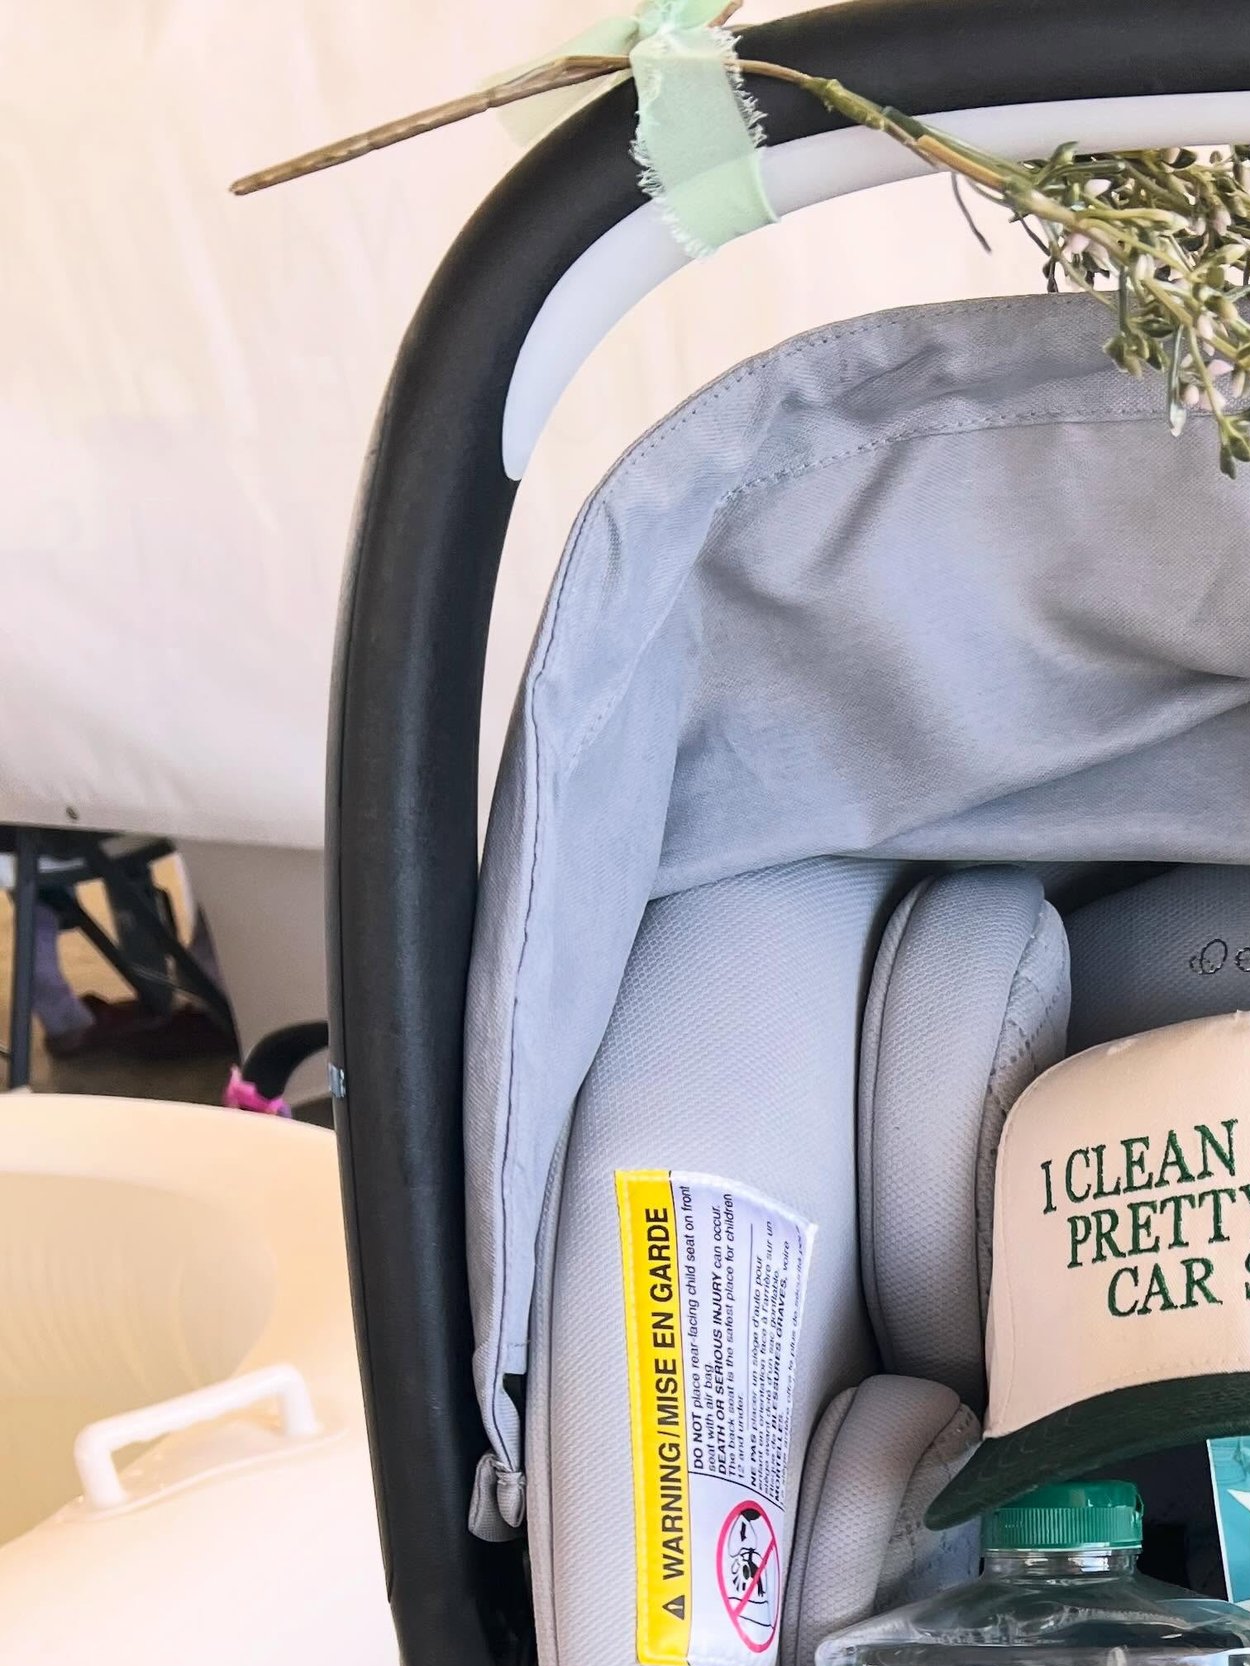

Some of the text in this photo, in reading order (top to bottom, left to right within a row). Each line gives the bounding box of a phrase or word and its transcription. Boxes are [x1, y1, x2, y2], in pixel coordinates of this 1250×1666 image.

[1040, 1159, 1057, 1214] I
[1065, 1118, 1238, 1203] CLEAN
[679, 1186, 691, 1211] front
[684, 1216, 694, 1231] on
[645, 1207, 673, 1303] GARDE
[684, 1234, 695, 1262] seat
[685, 1266, 696, 1296] child
[1107, 1258, 1223, 1318] CAR
[711, 1271, 722, 1326] INJURY
[651, 1312, 675, 1349] EN
[723, 1194, 737, 1476] The back seat is the safest place for children
[713, 1329, 724, 1395] SERIOUS
[692, 1374, 703, 1409] place
[704, 1393, 713, 1410] air
[715, 1399, 724, 1421] OR
[692, 1412, 702, 1443] NOT
[705, 1414, 715, 1440] with
[693, 1448, 704, 1470] DO
[707, 1444, 716, 1472] seat
[716, 1425, 726, 1476] DEATH
